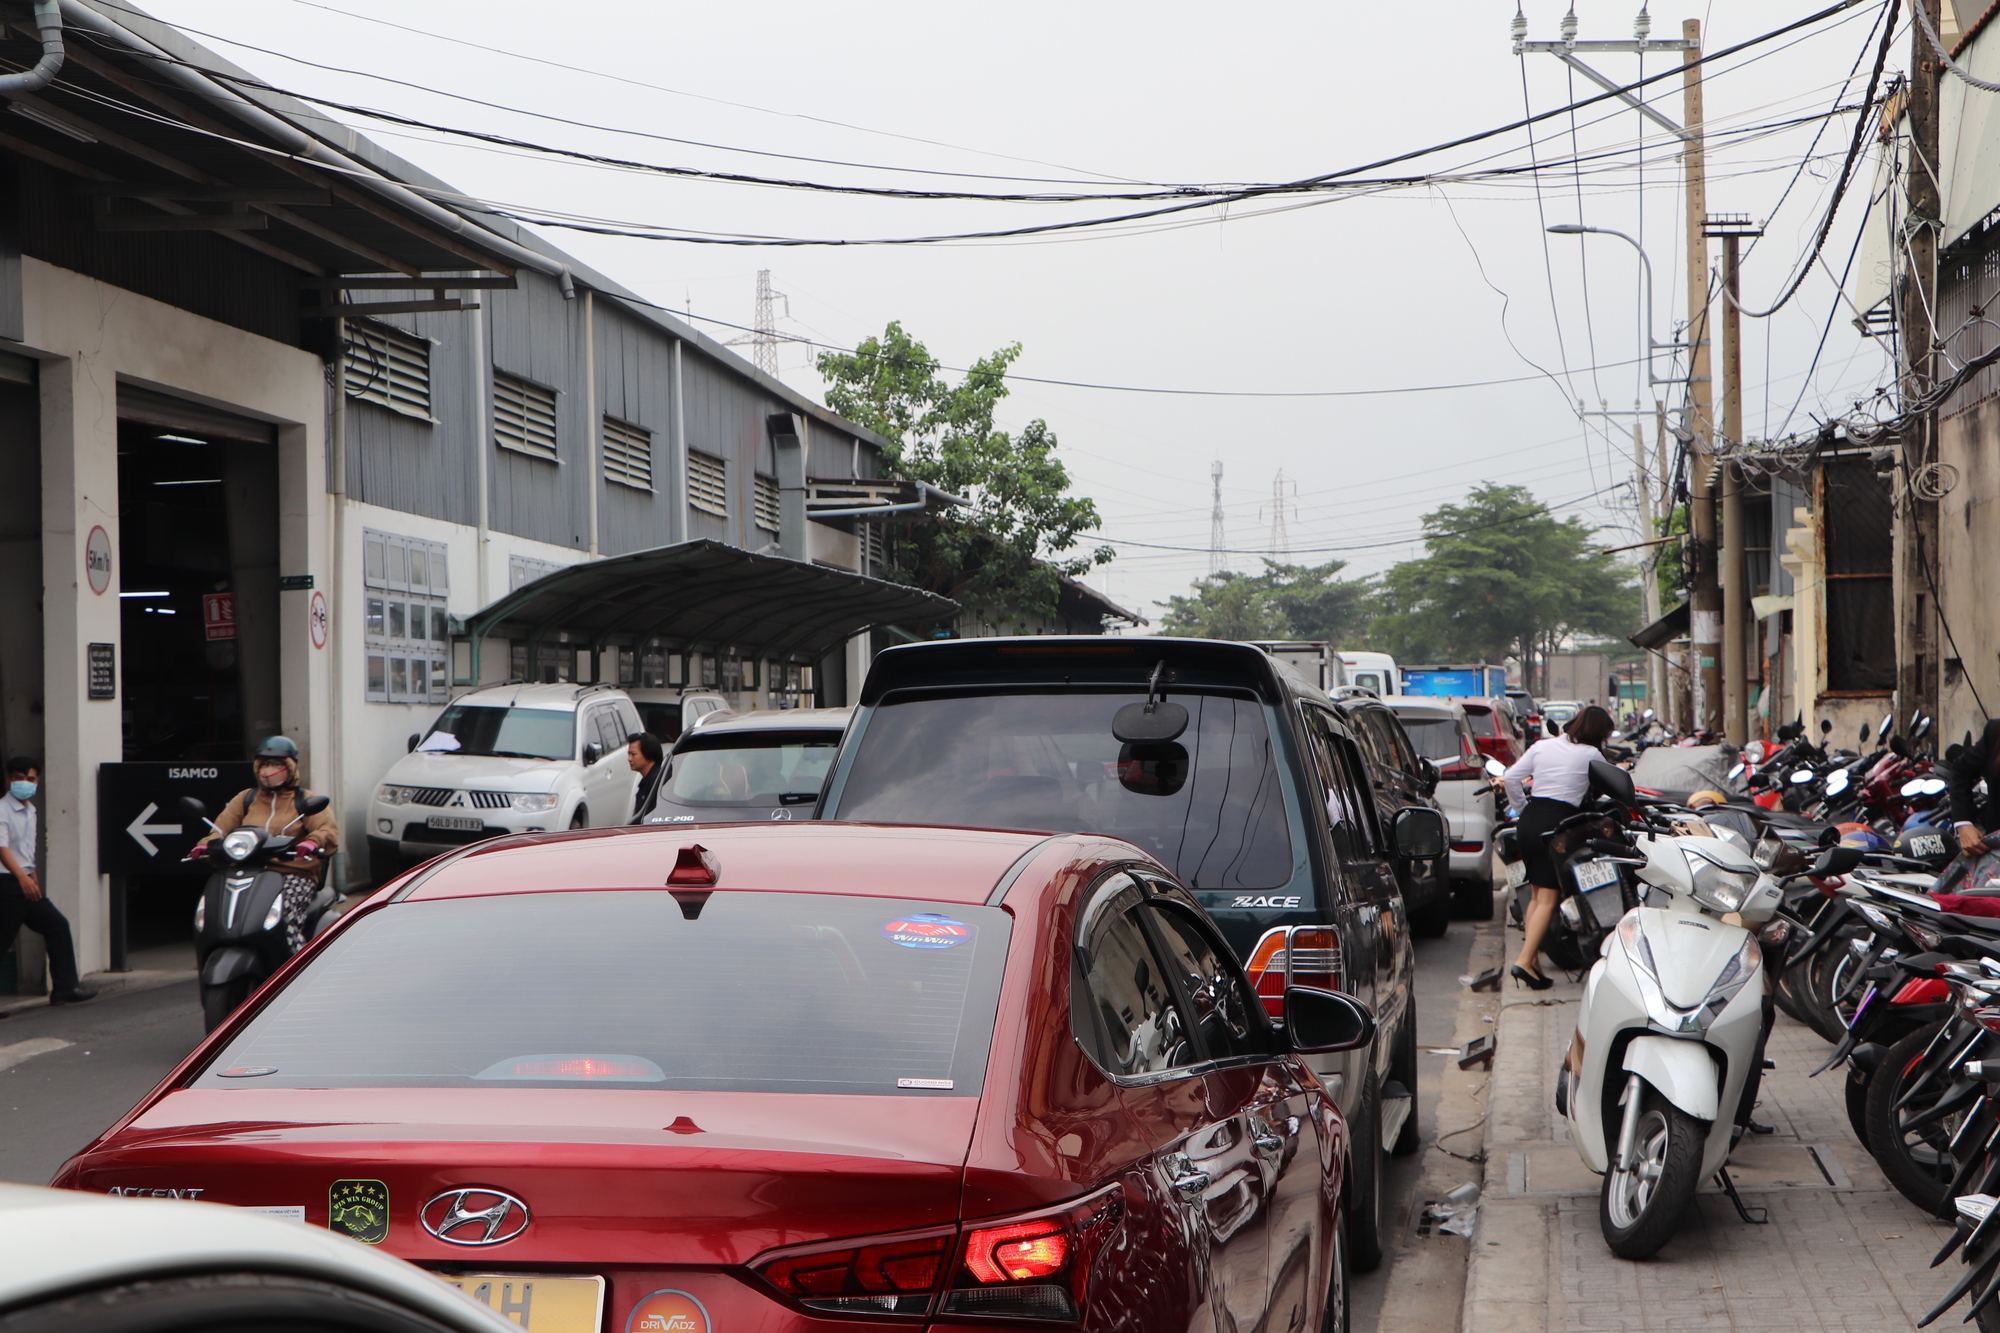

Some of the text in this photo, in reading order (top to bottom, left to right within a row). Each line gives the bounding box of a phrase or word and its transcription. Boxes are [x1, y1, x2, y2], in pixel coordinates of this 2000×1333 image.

[168, 767, 218, 779] ISAMCO
[673, 815, 695, 823] 200
[1580, 869, 1615, 890] 896.16
[1231, 895, 1301, 908] ZACE
[333, 1195, 385, 1210] WIN WIN GROUP
